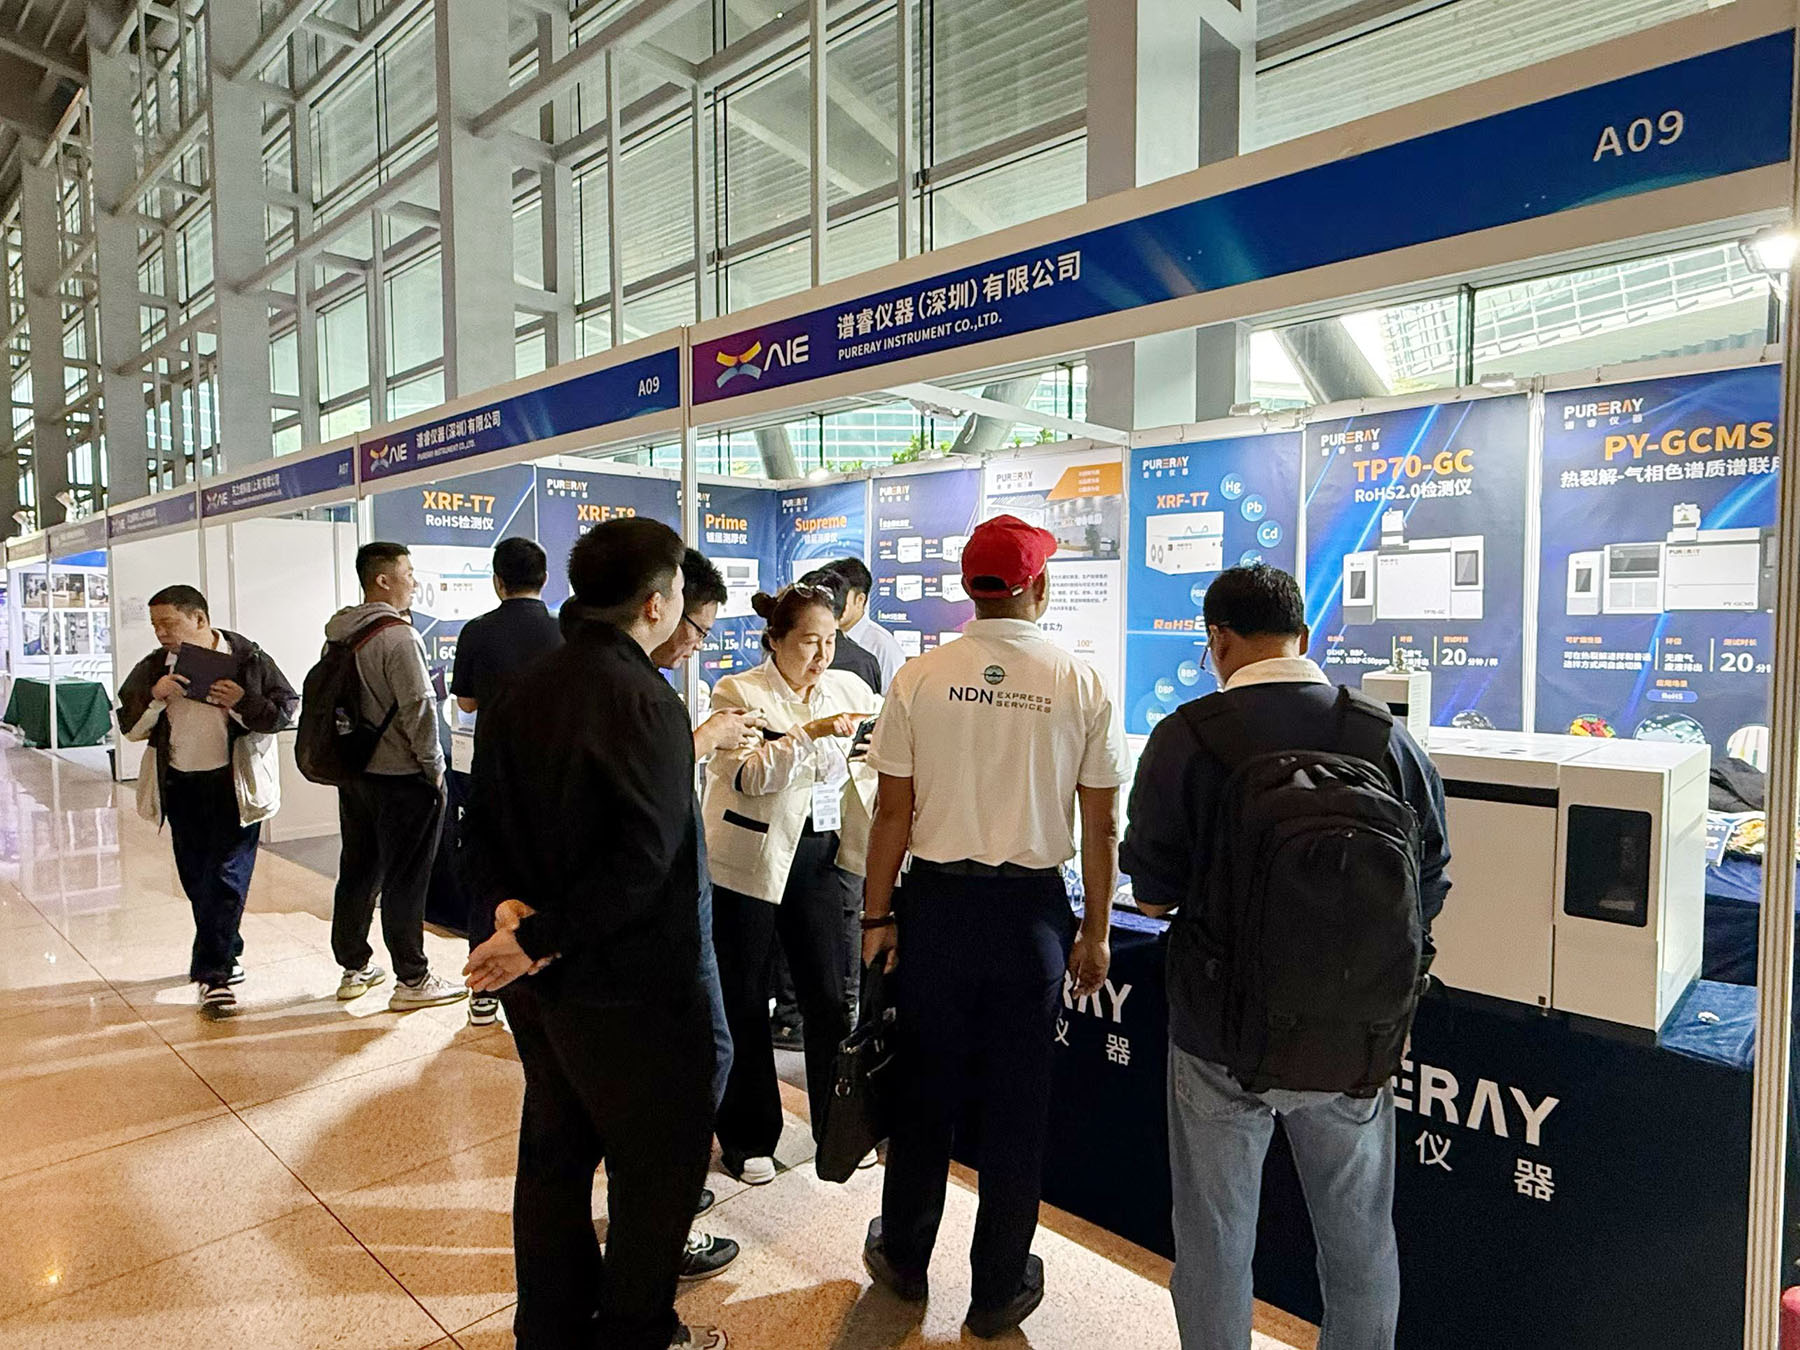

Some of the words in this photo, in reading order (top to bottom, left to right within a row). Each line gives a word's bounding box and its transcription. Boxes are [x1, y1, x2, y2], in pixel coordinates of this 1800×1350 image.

[1593, 110, 1684, 162] A09
[838, 338, 882, 361] PURERAY
[883, 324, 952, 352] INSTRUMENT
[953, 311, 1003, 335] CO.,LTD.
[638, 376, 660, 397] A09
[1564, 398, 1644, 420] PURERAY
[1321, 428, 1381, 447] PURERAY
[1605, 421, 1774, 461] PY-GCMS
[1142, 455, 1190, 471] PURERAY
[1353, 449, 1474, 483] TP70-GC
[547, 479, 587, 491] PURERAY
[996, 471, 1033, 483] PURERAY
[1225, 481, 1241, 494] Hg
[1355, 477, 1472, 503] RoHS2.0检测仪
[422, 490, 495, 514] XRF-T7
[1156, 491, 1209, 509] XRF-T7
[1247, 502, 1262, 513] Pb
[425, 514, 494, 530] RoHS检测仪
[705, 513, 747, 530] Prime
[795, 516, 847, 532] Supreme
[1262, 527, 1278, 540] Cd
[1441, 648, 1467, 666] 20
[1720, 652, 1754, 672] 20
[949, 686, 993, 705] NDN
[997, 691, 1052, 705] EXPRESS
[996, 700, 1051, 713] SERVICES
